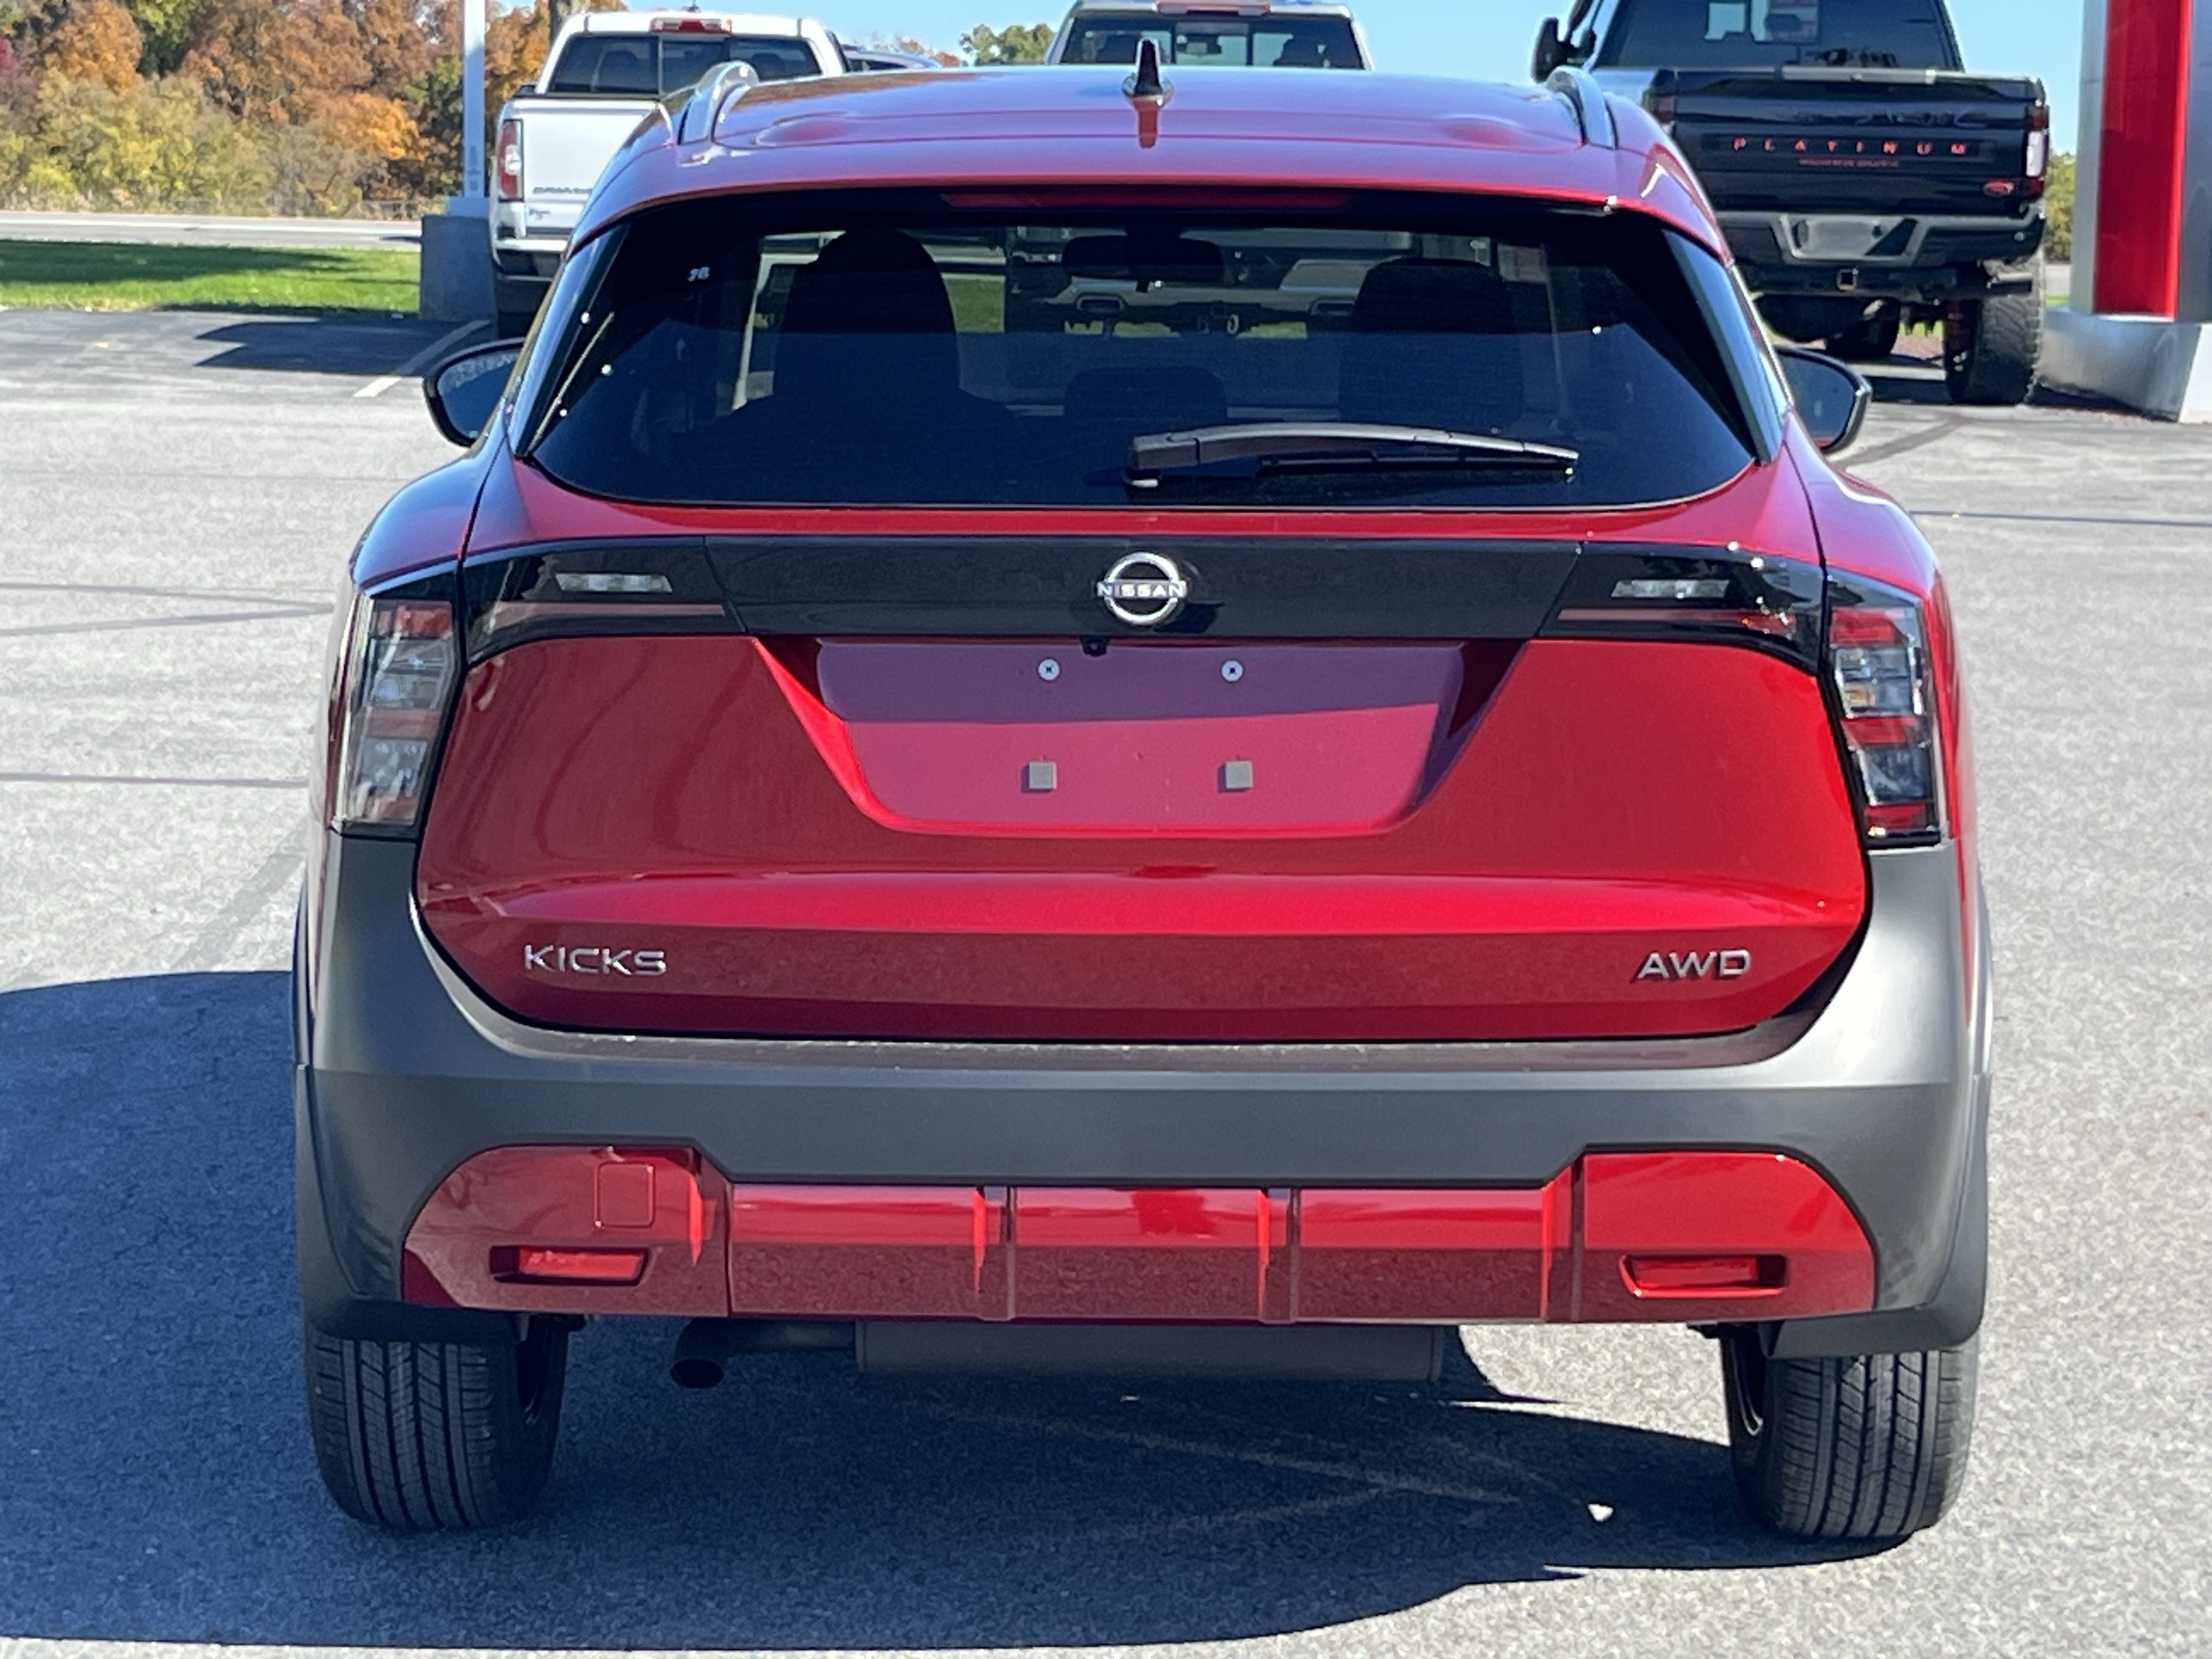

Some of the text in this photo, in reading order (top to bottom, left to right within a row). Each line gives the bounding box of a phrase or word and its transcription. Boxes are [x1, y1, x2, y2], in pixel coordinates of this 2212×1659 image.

[1732, 137, 1967, 156] PLATINUM
[1097, 580, 1187, 598] NISSAN
[524, 944, 667, 976] KICKS
[1637, 949, 1751, 979] AWD
